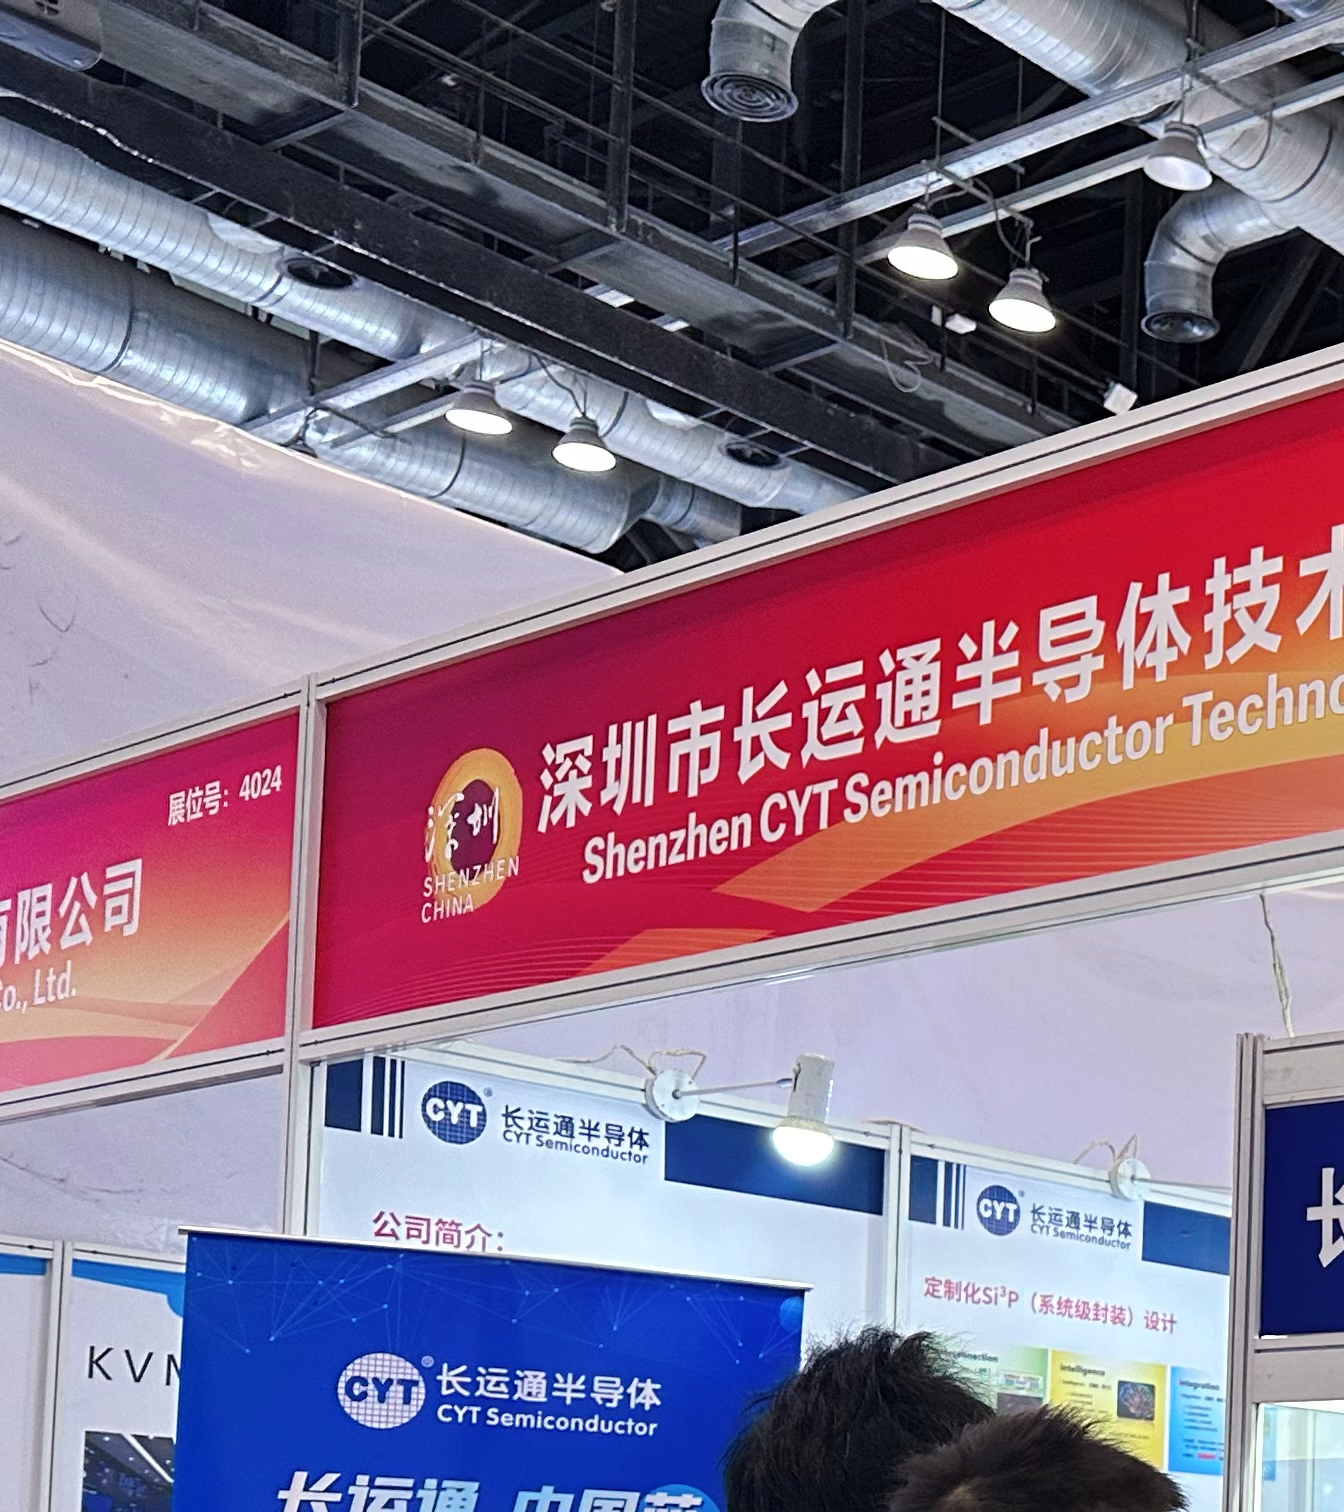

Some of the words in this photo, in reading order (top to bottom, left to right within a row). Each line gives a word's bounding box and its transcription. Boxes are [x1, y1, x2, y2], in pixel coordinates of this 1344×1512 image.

[582, 812, 752, 885] Shenzhen
[759, 780, 839, 845] CYT
[843, 710, 1175, 824] Semiconductor
[422, 855, 520, 898] SHENZHEN
[421, 893, 475, 924] CHINA
[0, 980, 28, 1014] o.,
[33, 959, 77, 1006] Ltd.
[425, 1098, 483, 1129] CYT
[501, 1105, 651, 1152] 长运通半导体
[503, 1129, 535, 1146] CYT
[535, 1133, 649, 1166] Semiconductor
[979, 1197, 1018, 1223] CYT
[1029, 1203, 1133, 1239] 长运通半导体
[372, 1210, 505, 1253] 公司简介：
[1030, 1223, 1051, 1237] CYT
[1051, 1225, 1131, 1250] Semiconductor
[344, 1373, 421, 1408] CYT
[435, 1362, 662, 1412] 长运通半导体
[436, 1403, 482, 1424] CYT
[485, 1406, 658, 1437] Semiconductor
